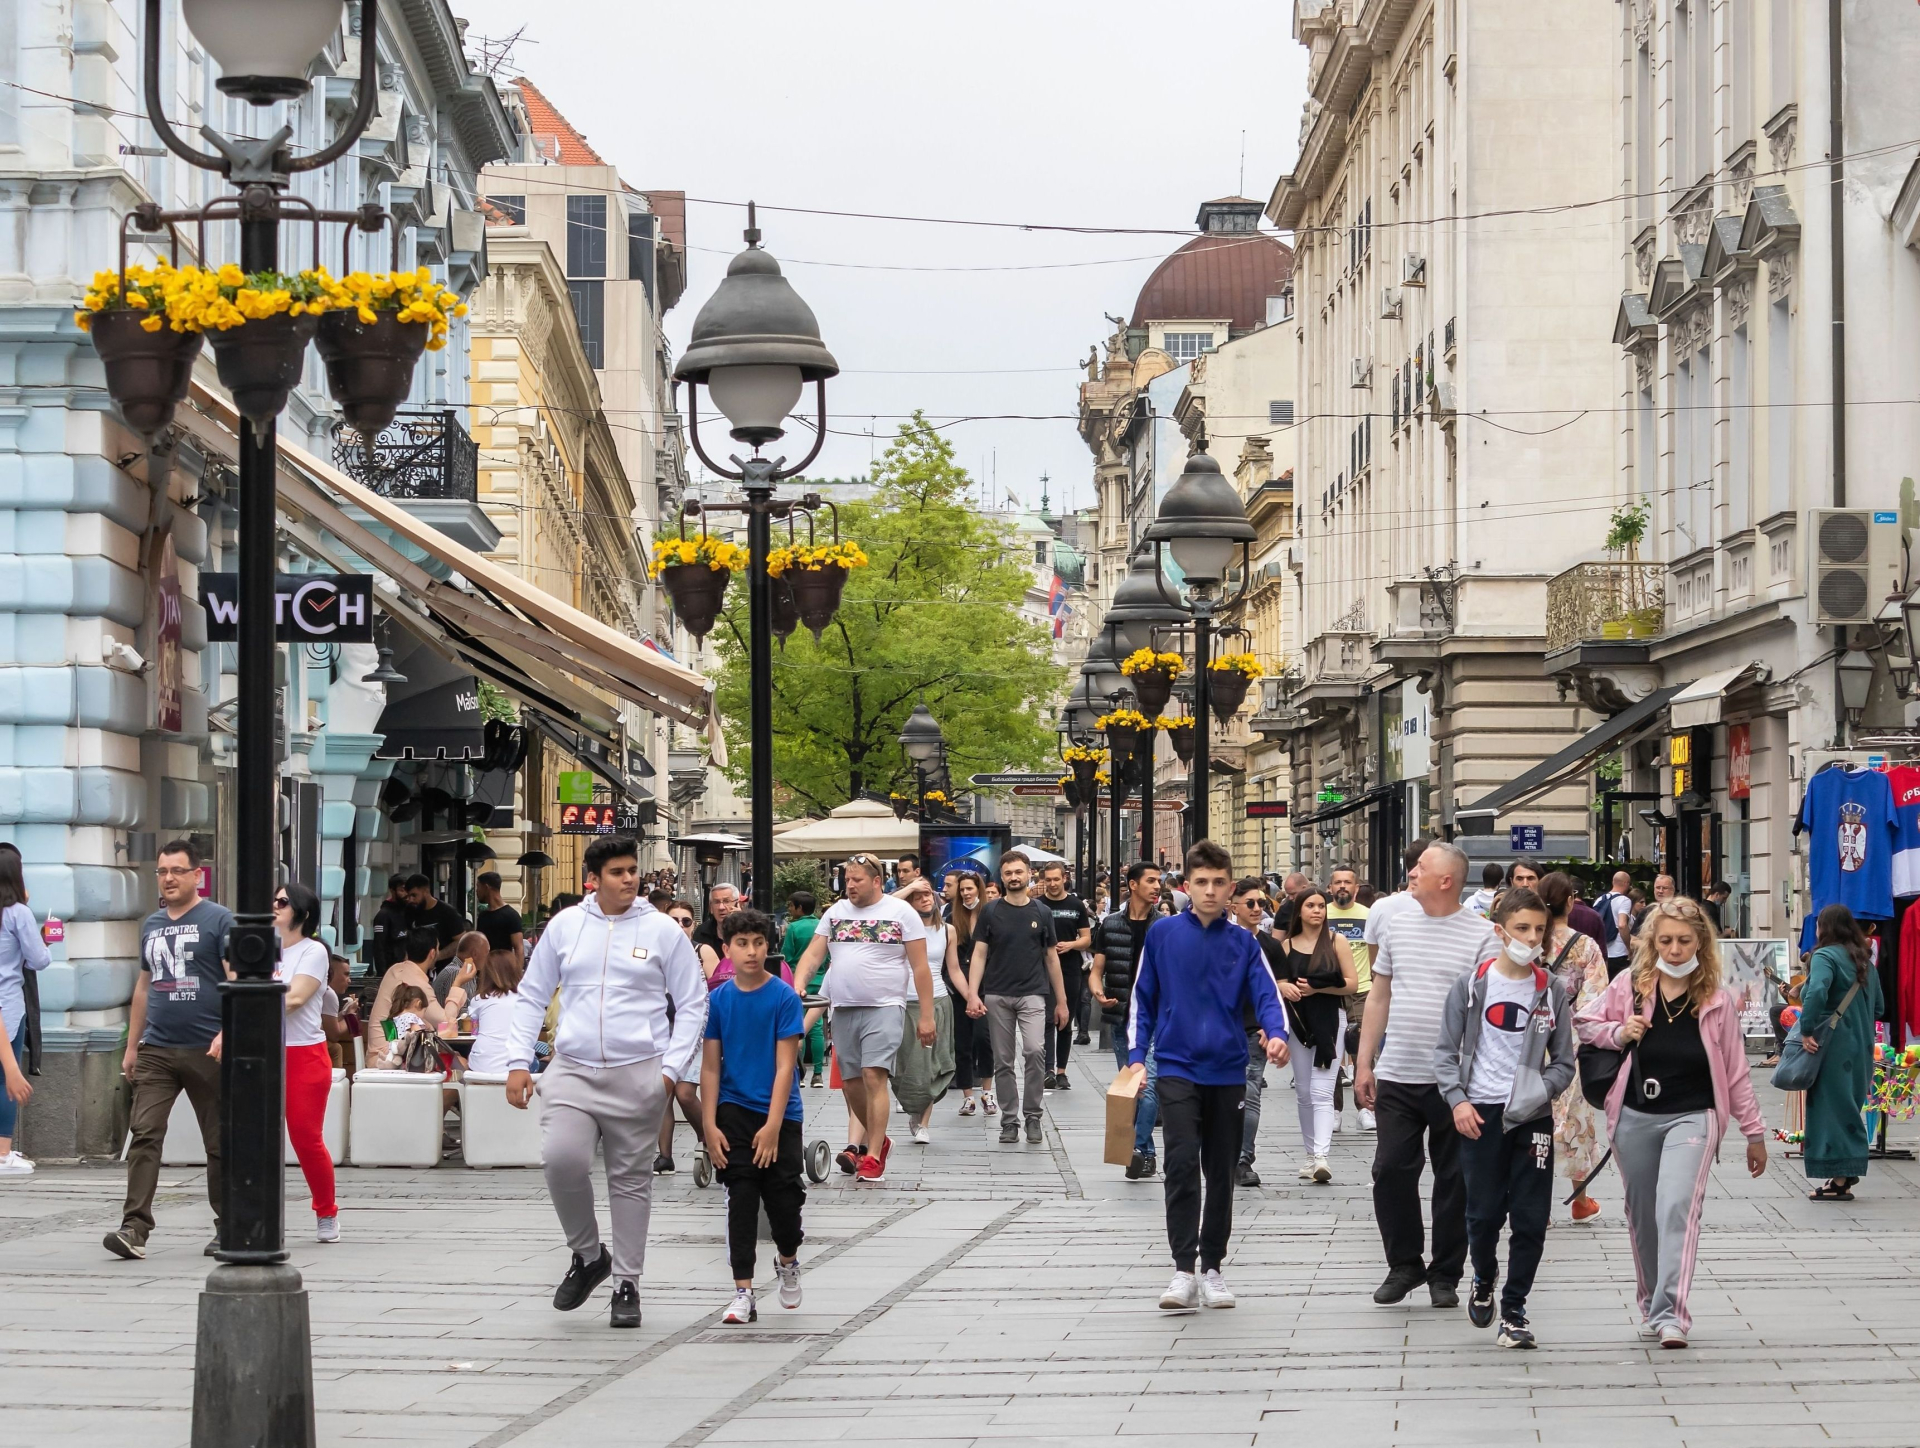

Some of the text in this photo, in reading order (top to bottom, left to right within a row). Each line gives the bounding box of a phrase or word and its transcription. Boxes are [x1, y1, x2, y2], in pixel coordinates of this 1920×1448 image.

[207, 580, 365, 635] WTCH
[164, 924, 199, 936] CONTROL
[169, 992, 196, 1001] NO.975
[1531, 1132, 1551, 1146] JUST
[1536, 1144, 1549, 1158] DO
